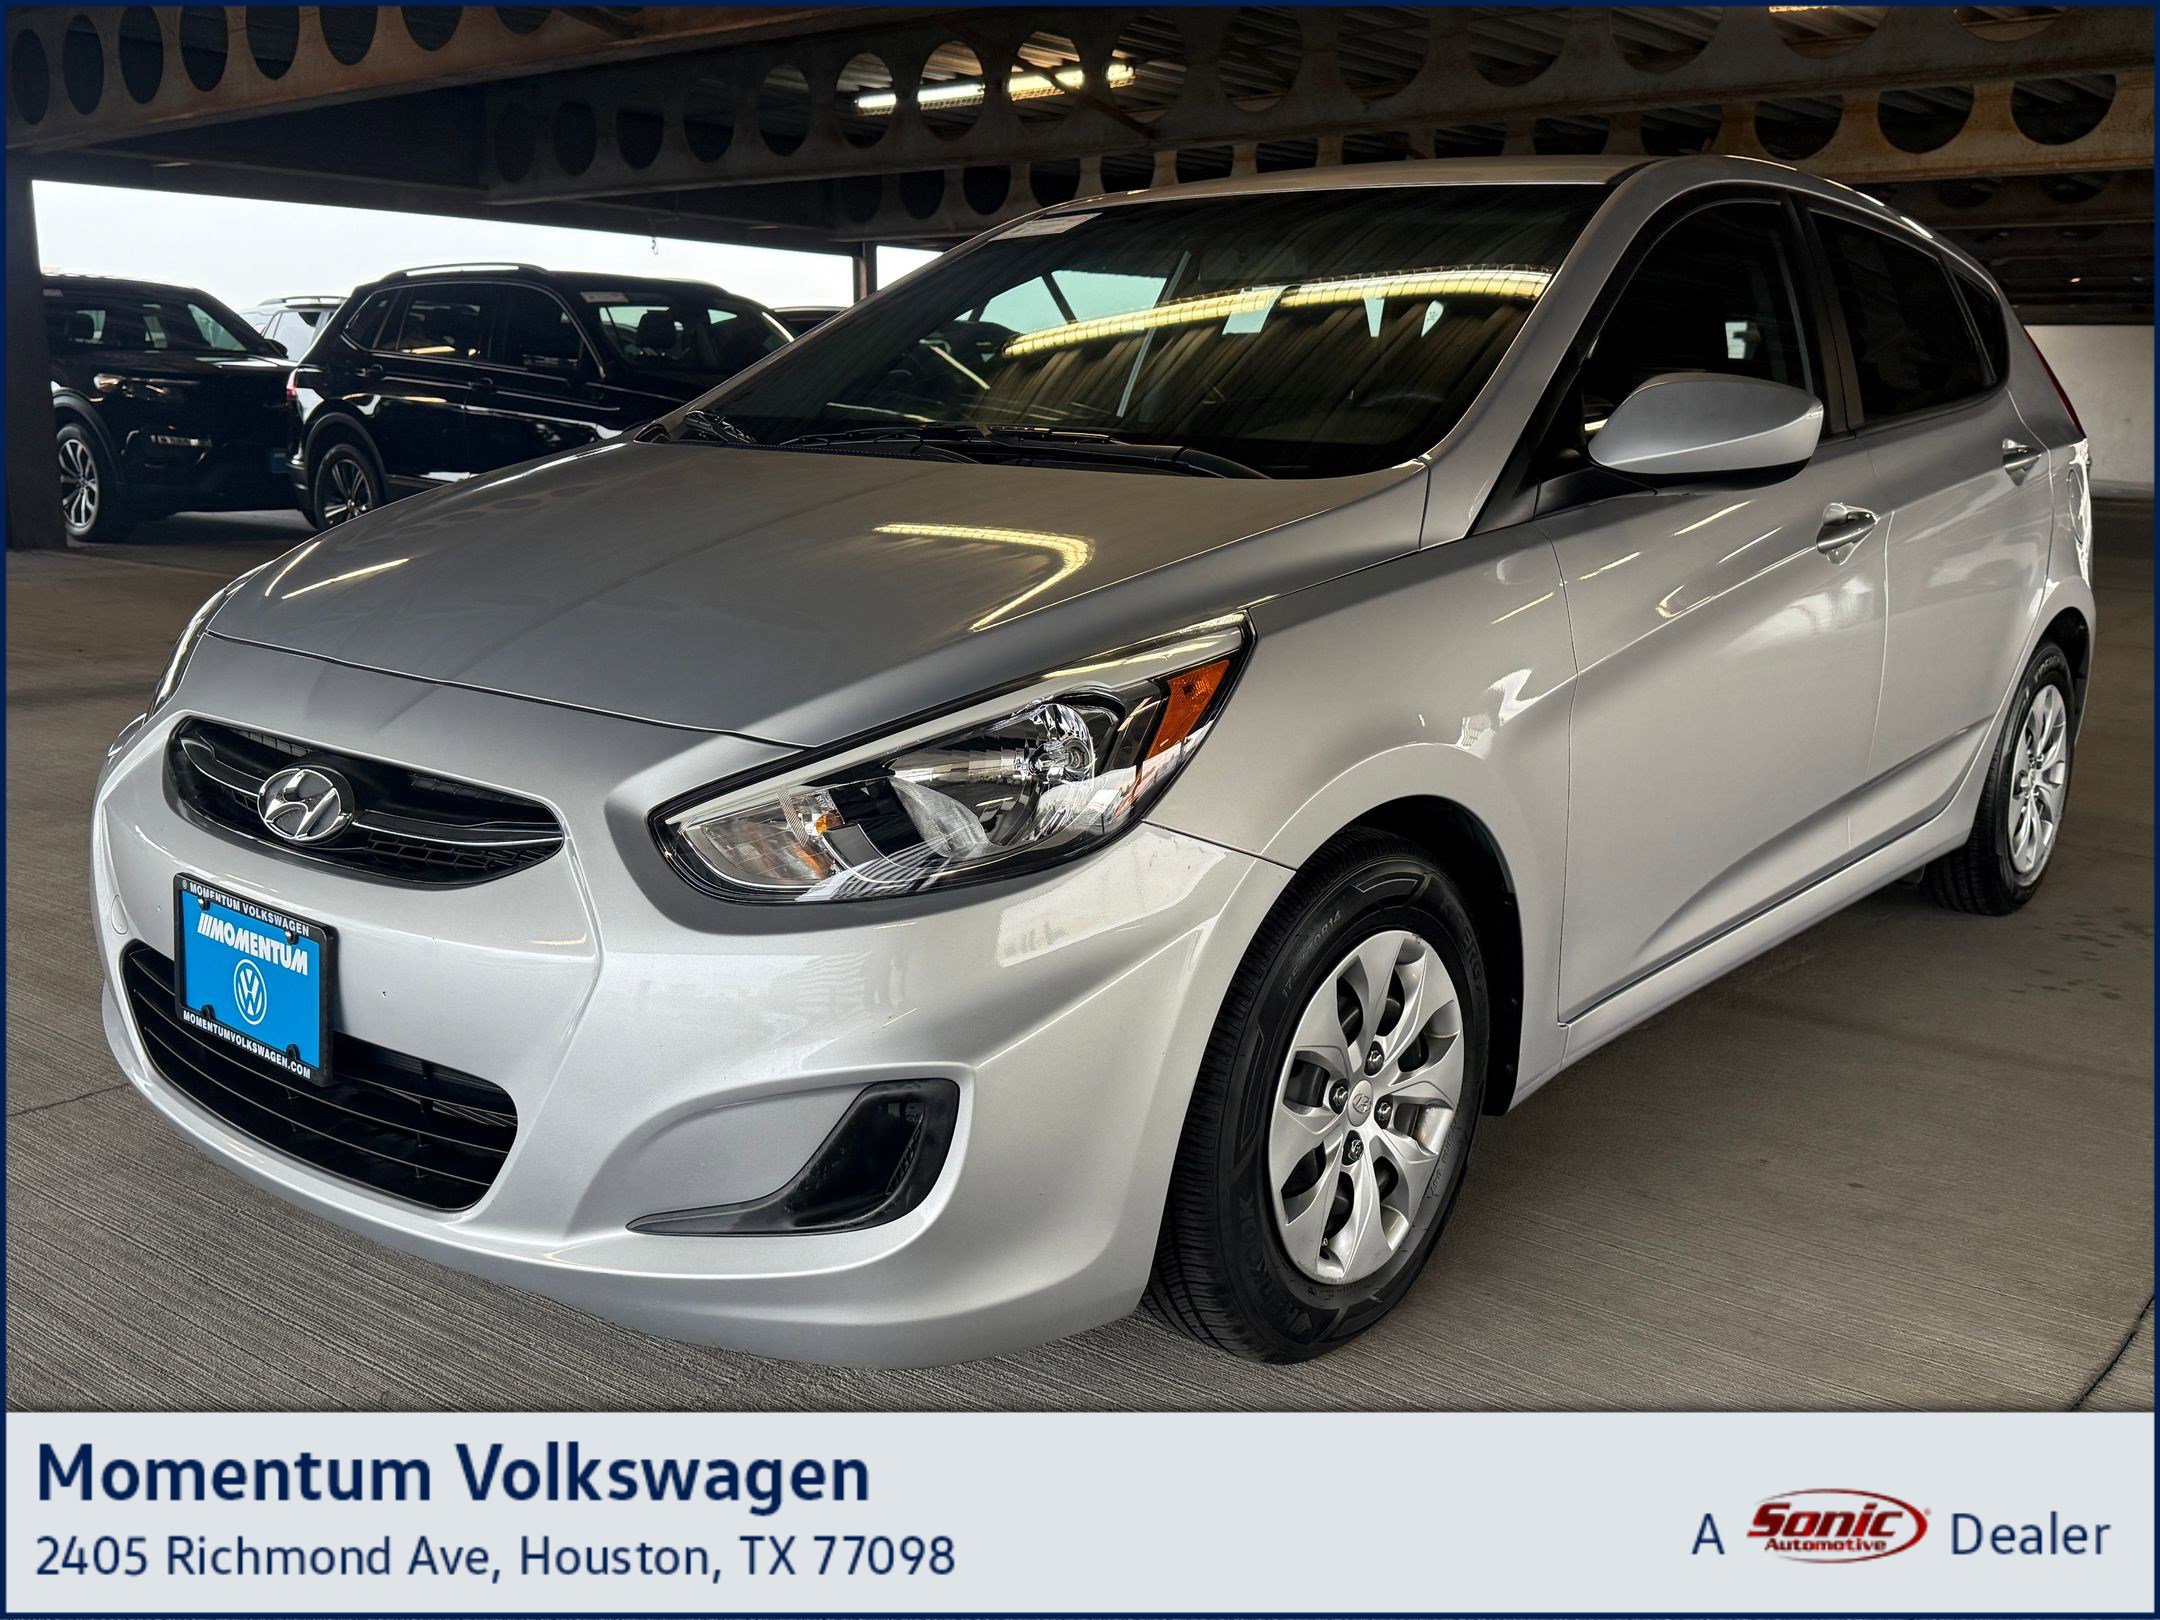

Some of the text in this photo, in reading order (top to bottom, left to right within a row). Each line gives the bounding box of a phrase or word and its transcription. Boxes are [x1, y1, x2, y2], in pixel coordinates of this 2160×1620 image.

[190, 882, 310, 937] MOMENTUM VOLKSWAGEN
[183, 1010, 311, 1079] MOMENTUMVOLKSWAGEN.COM
